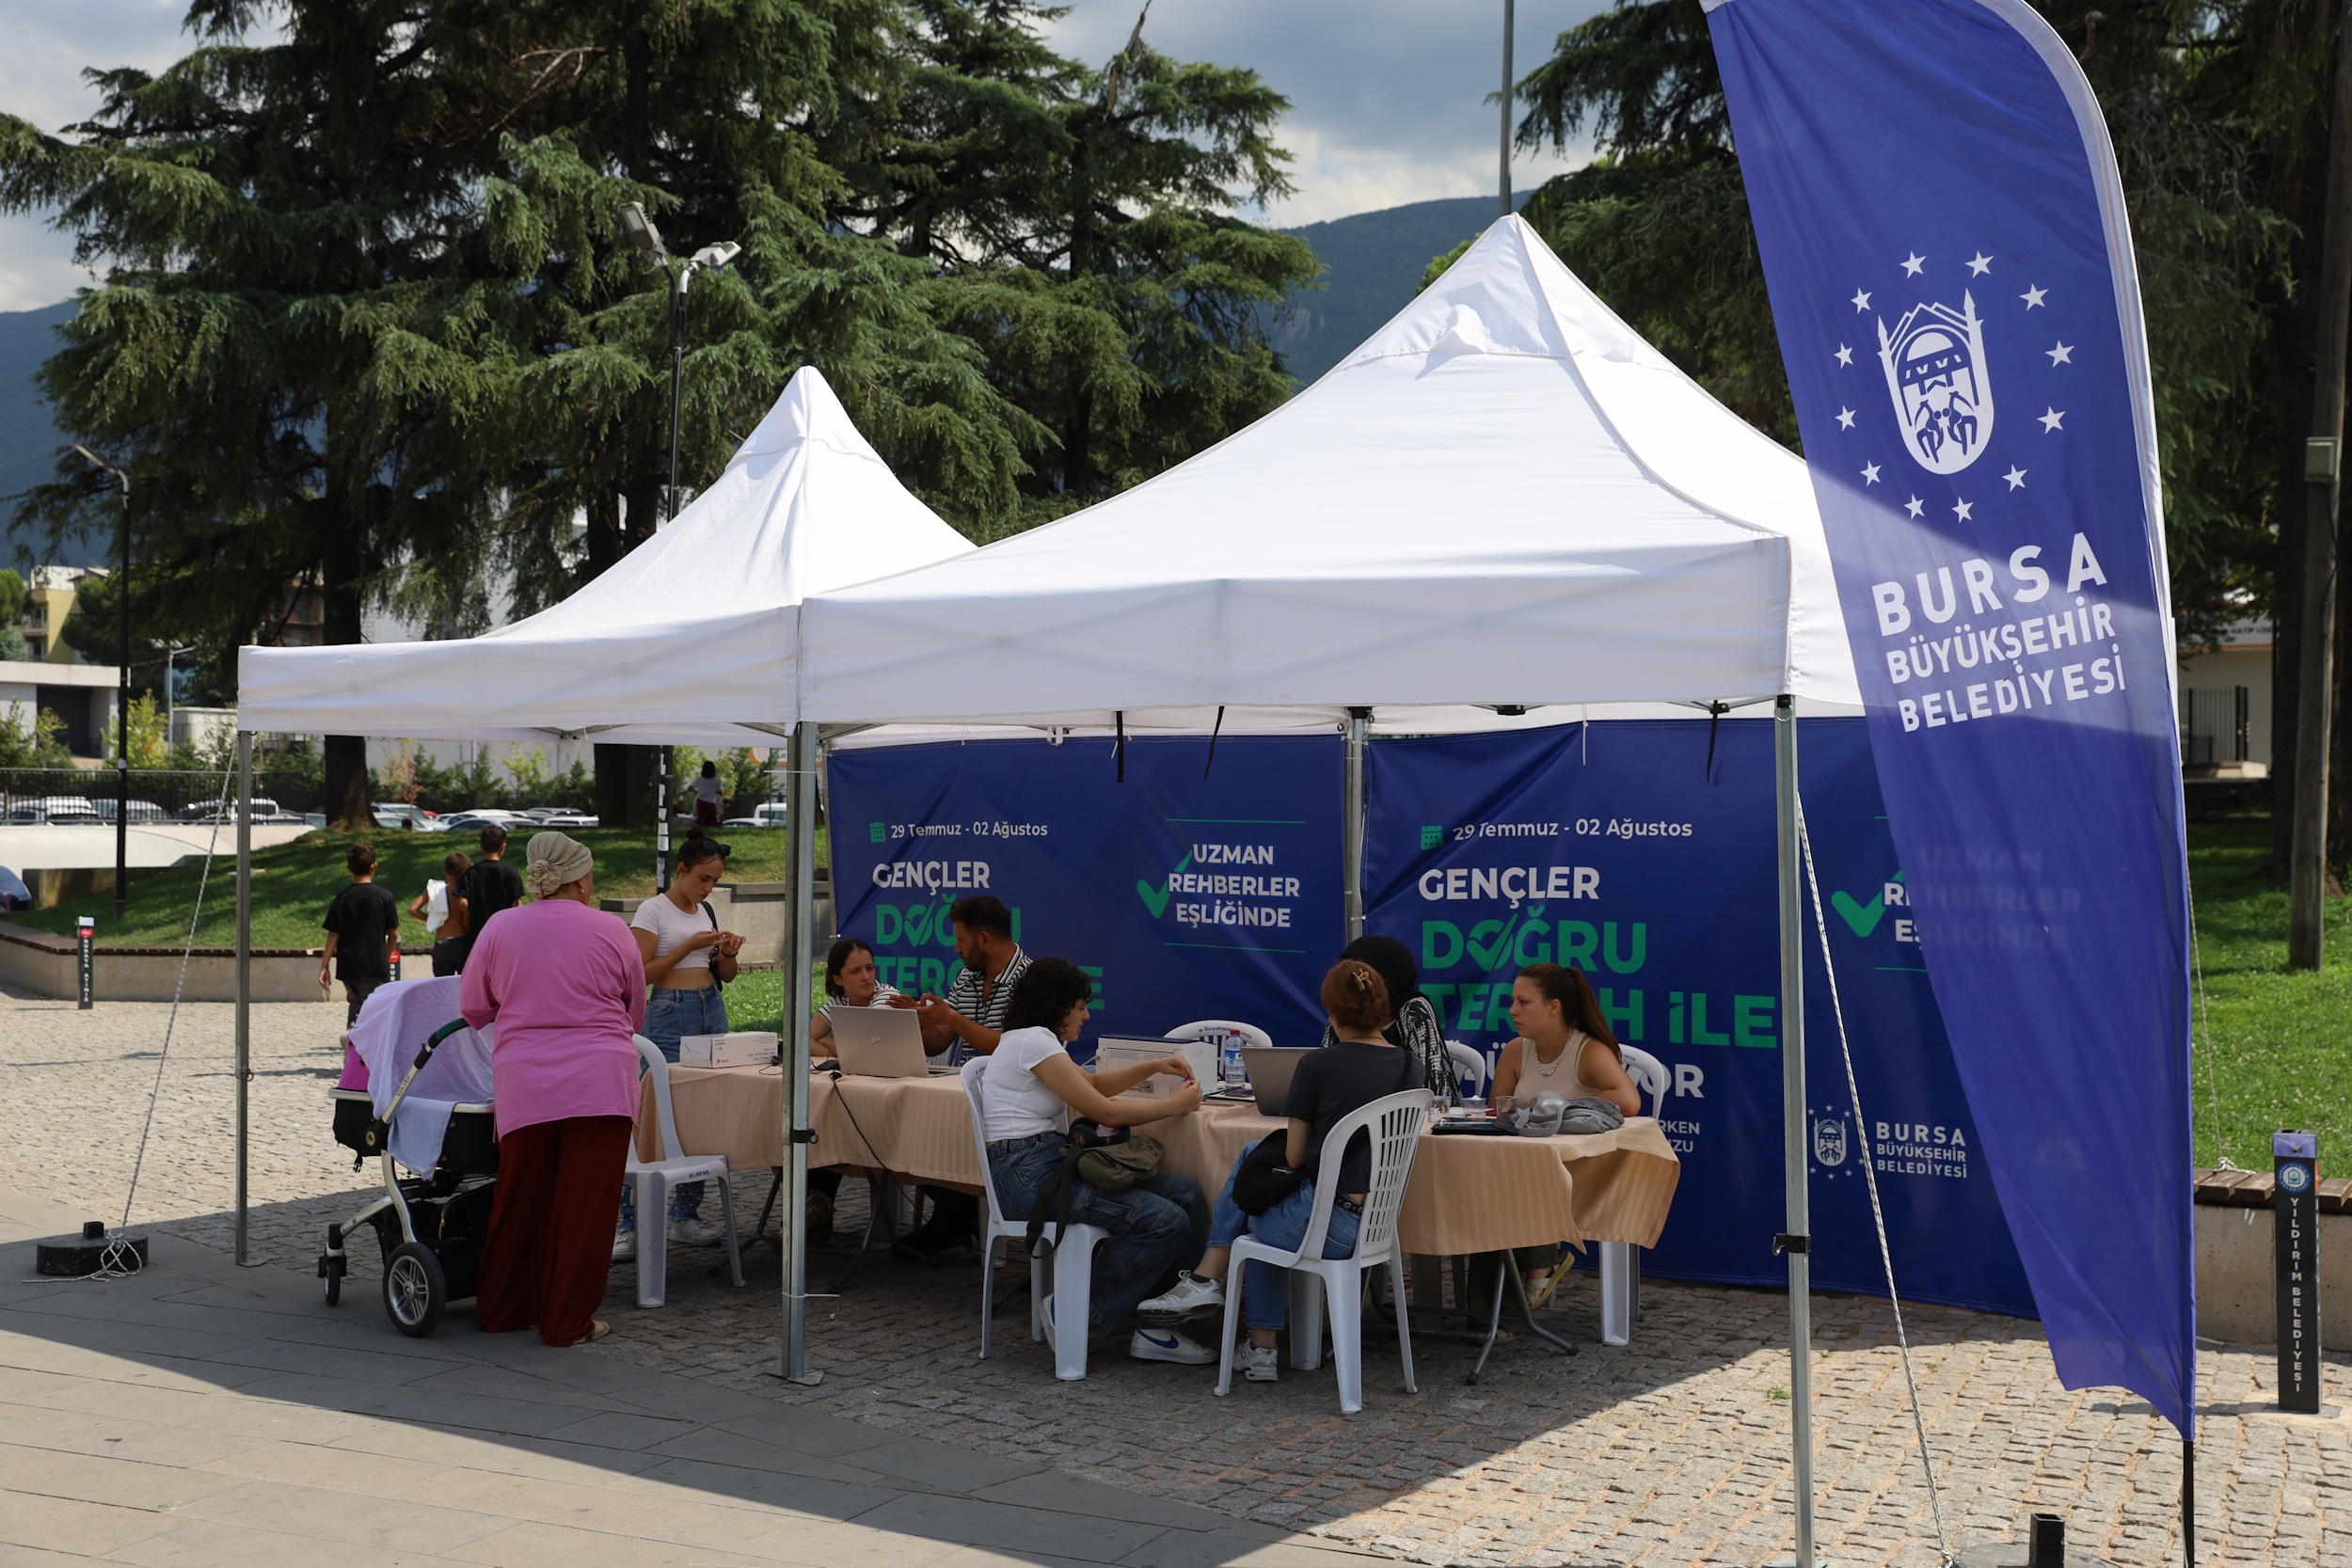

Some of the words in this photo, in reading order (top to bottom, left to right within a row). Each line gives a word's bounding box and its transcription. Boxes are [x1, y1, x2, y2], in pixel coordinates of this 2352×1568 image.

[1872, 531, 2107, 637] BURSA
[1885, 595, 2116, 684] BÜYÜKŞEHİR
[1898, 642, 2125, 732] BELEDİYESİ
[891, 824, 905, 838] 29
[908, 824, 961, 837] Temmuz
[973, 821, 989, 835] 02
[992, 820, 1048, 839] Ağustos
[1452, 824, 1475, 841] 29
[1479, 821, 1559, 838] Temmuz
[1575, 818, 1600, 835] 02
[1606, 818, 1692, 840] Ağustos
[1193, 844, 1274, 864] UZMAN
[873, 861, 991, 895] GENÇLER
[1168, 873, 1300, 897] REHBERLER
[1418, 866, 1599, 910] GENÇLER
[1176, 899, 1291, 928] EŞLİĞİNDE
[1422, 905, 1646, 974] DOĞRU
[1669, 990, 1777, 1049] İLE
[1876, 1121, 1966, 1147] BURSA
[1877, 1142, 1966, 1163] BÜYÜKŞEHİR
[1877, 1159, 1967, 1179] BELEDİYESİ
[2290, 1197, 2302, 1281] YILDIRIM
